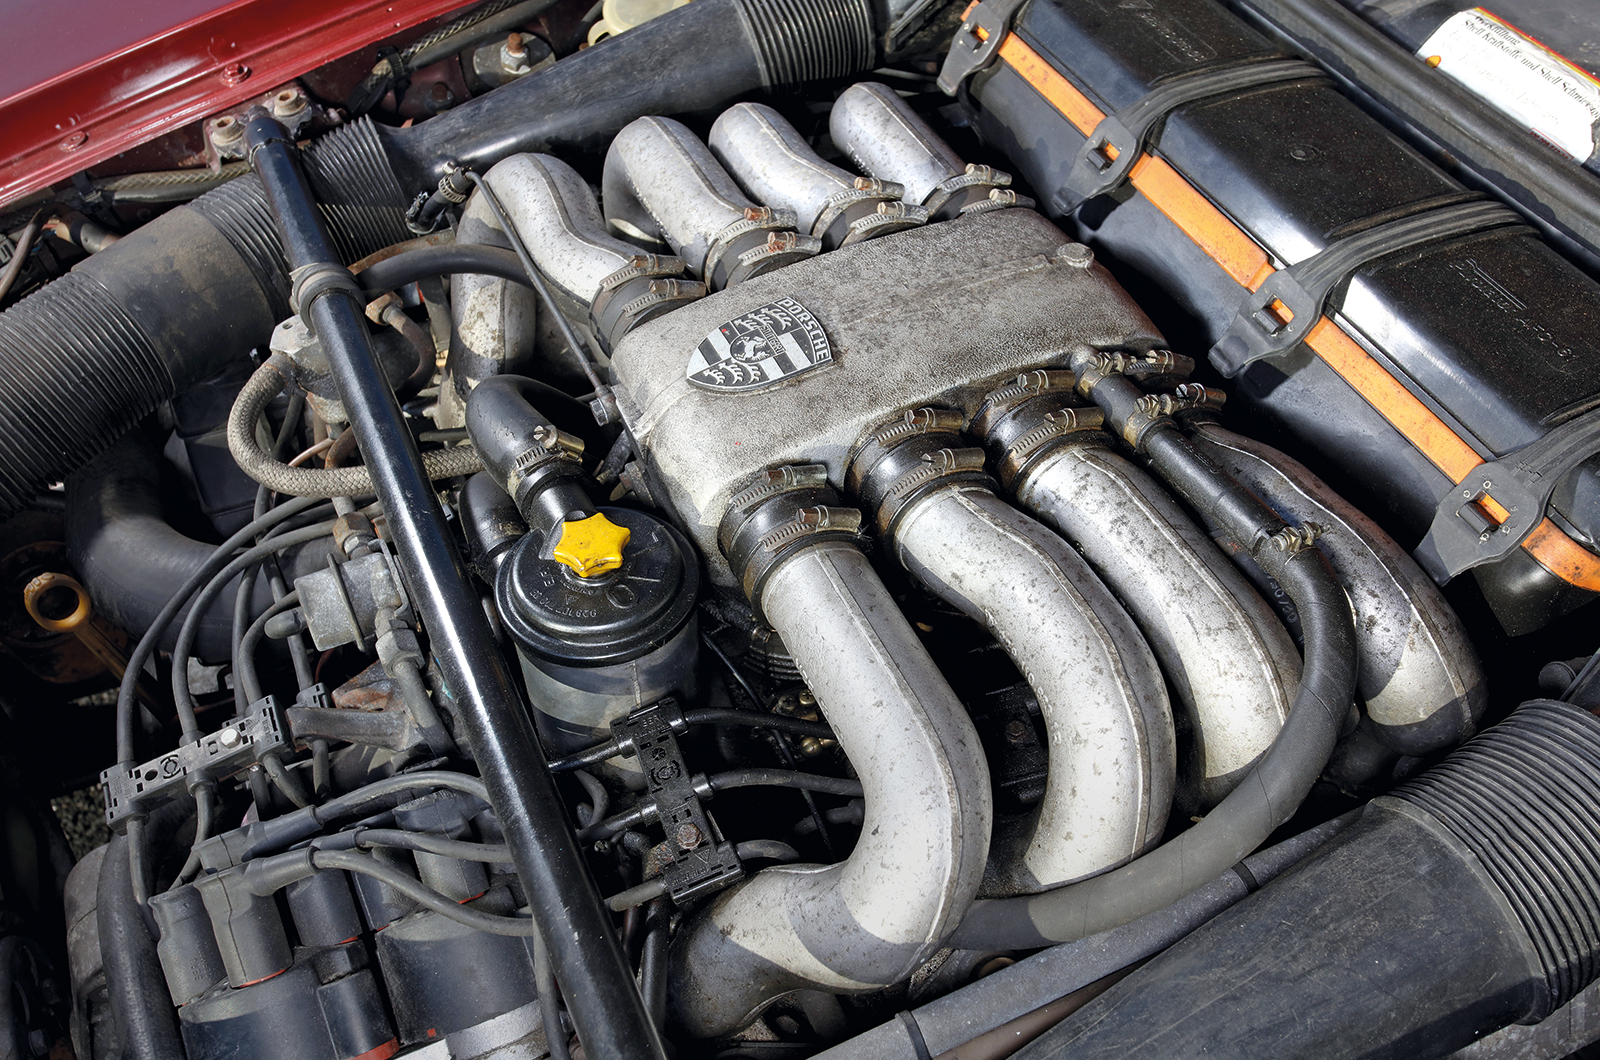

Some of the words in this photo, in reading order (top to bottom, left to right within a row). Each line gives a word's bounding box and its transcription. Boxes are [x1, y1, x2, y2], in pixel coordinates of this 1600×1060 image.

[1464, 19, 1486, 36] Shell
[1481, 32, 1523, 60] Kraftstoffe
[1520, 57, 1541, 72] und
[1540, 66, 1563, 85] Shell
[778, 298, 830, 362] PORSCHE
[189, 957, 202, 981] BERU
